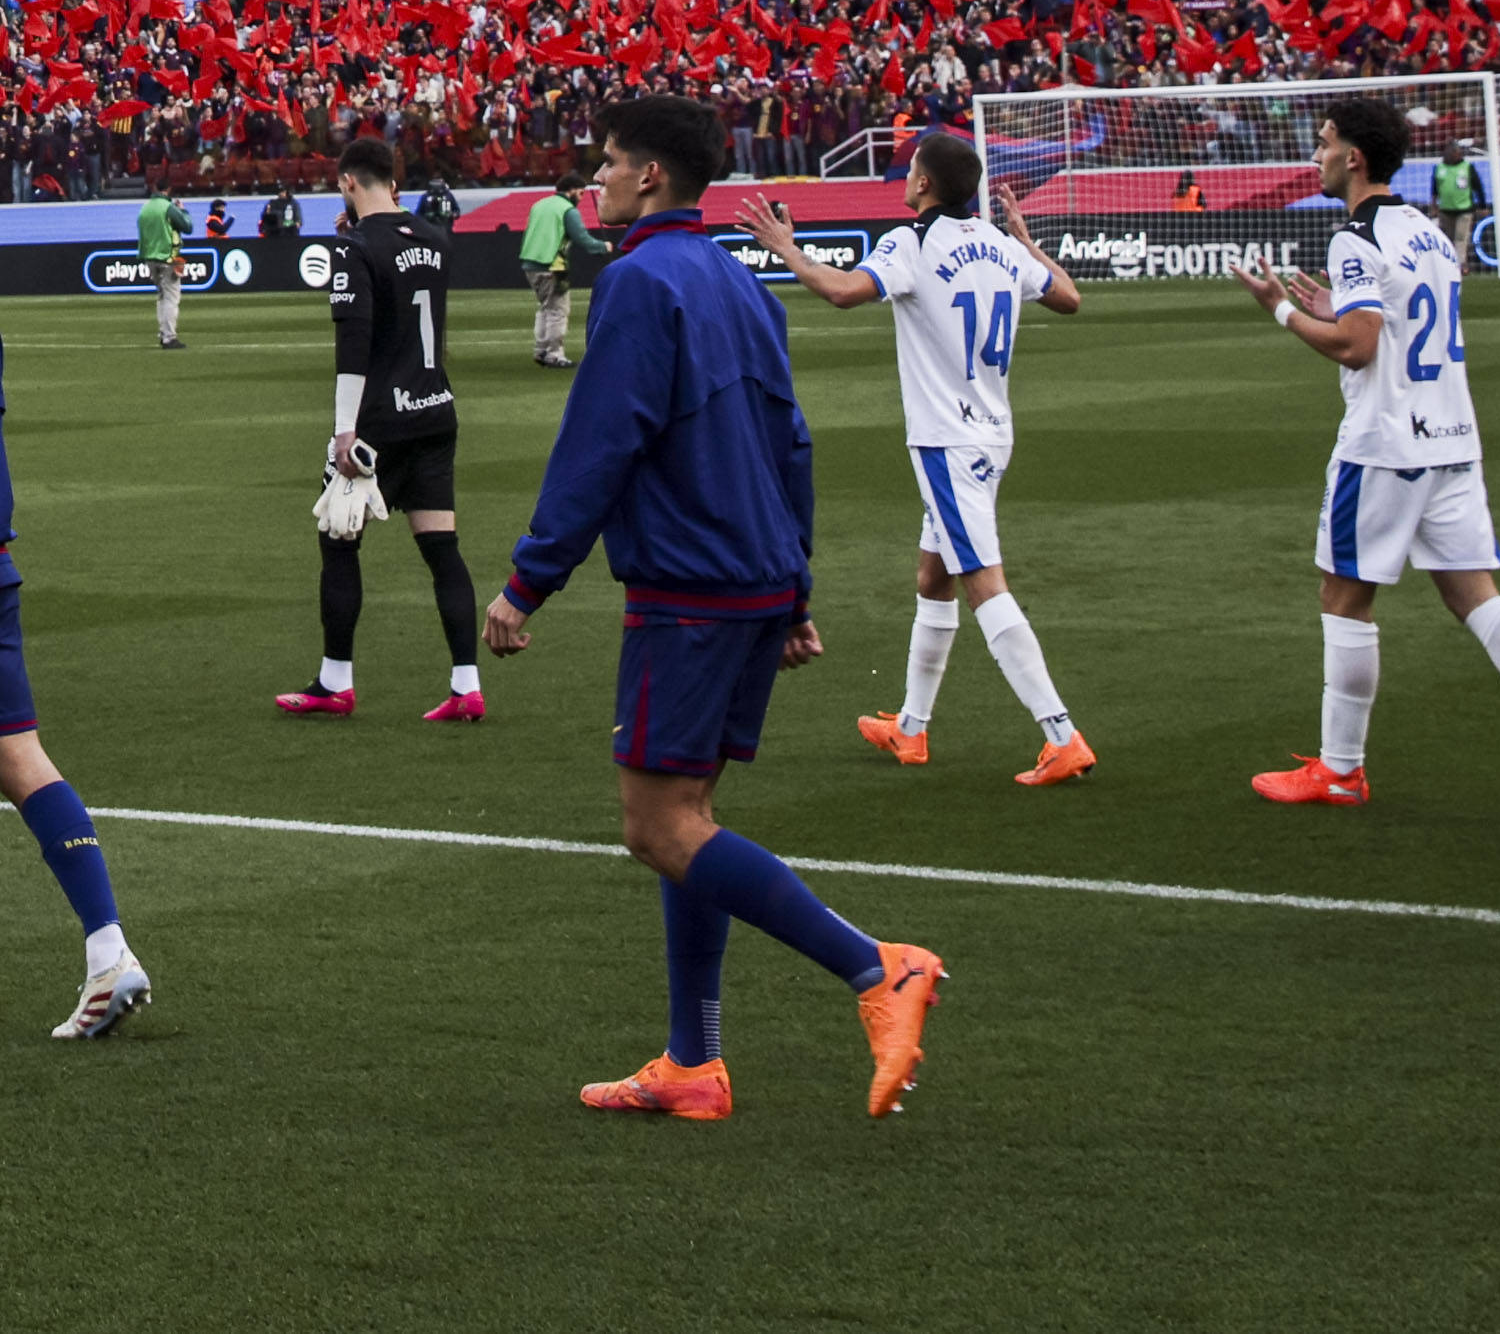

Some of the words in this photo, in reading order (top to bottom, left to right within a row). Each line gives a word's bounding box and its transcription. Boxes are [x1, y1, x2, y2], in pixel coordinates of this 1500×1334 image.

[105, 261, 138, 282] play
[395, 248, 442, 272] SIVERA
[412, 289, 435, 369] 1
[951, 290, 1012, 380] 14
